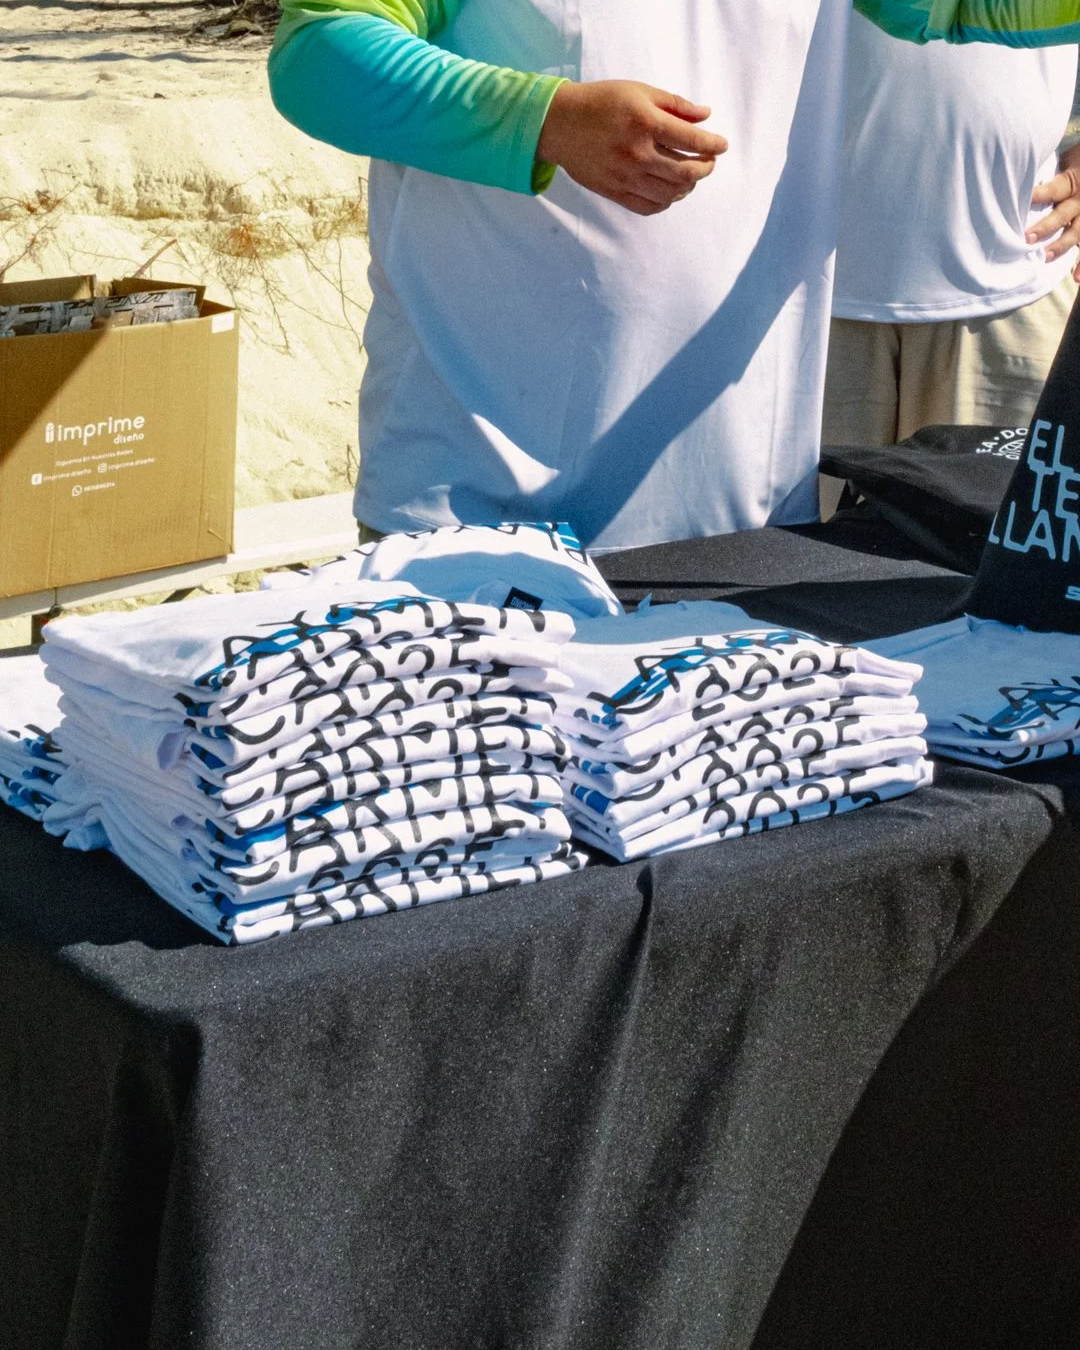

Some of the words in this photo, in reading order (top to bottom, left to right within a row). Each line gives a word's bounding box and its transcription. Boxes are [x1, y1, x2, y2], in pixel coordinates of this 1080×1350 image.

[57, 415, 145, 446] imprime
[113, 433, 145, 444] diseño
[1027, 419, 1076, 474] EL
